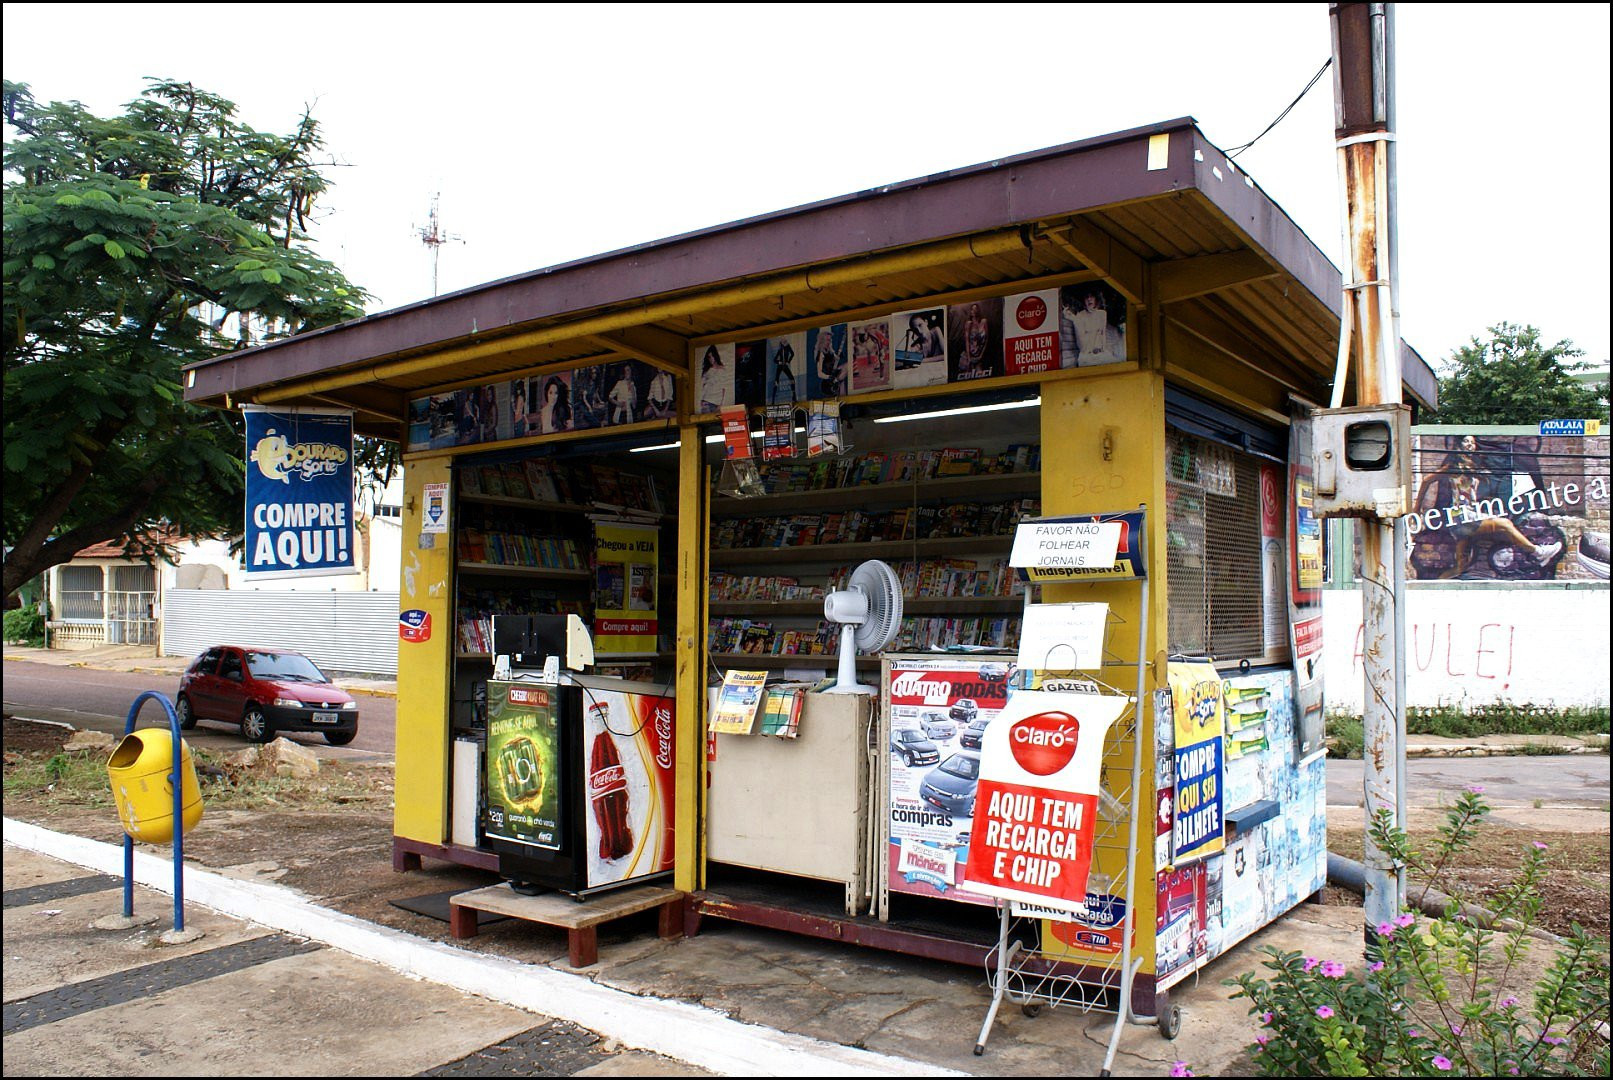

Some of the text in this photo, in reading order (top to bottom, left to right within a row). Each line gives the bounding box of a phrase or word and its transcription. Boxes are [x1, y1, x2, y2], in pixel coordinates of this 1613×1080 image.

[1018, 308, 1042, 320] Claro
[1014, 336, 1052, 353] AQUI TEM
[1015, 349, 1052, 364] RECARGA
[1027, 363, 1048, 375] CHIP
[1542, 420, 1583, 429] ATALAIA
[1586, 422, 1596, 432] 34
[302, 459, 337, 478] Sorte
[253, 502, 346, 529] COMPRE
[1035, 524, 1100, 535] FAVOR NÃO
[253, 527, 349, 568] AQUI!
[596, 538, 655, 553] Chegou a VEJA
[1038, 541, 1090, 550] FOLHEAR
[1037, 556, 1085, 566] JORNAIS
[602, 621, 649, 634] Compre aqui!
[891, 677, 1008, 701] QUATRO RODAS
[1046, 682, 1098, 693] GAZETA
[1014, 725, 1065, 748] Claro
[1202, 774, 1217, 804] SEU
[891, 809, 953, 828] compras
[987, 790, 1084, 831] AQUI TEM
[1176, 801, 1219, 850] BILHETE
[985, 820, 1077, 861] RECARGA
[993, 852, 1061, 888] E CHIP
[1091, 934, 1107, 945] TIM
